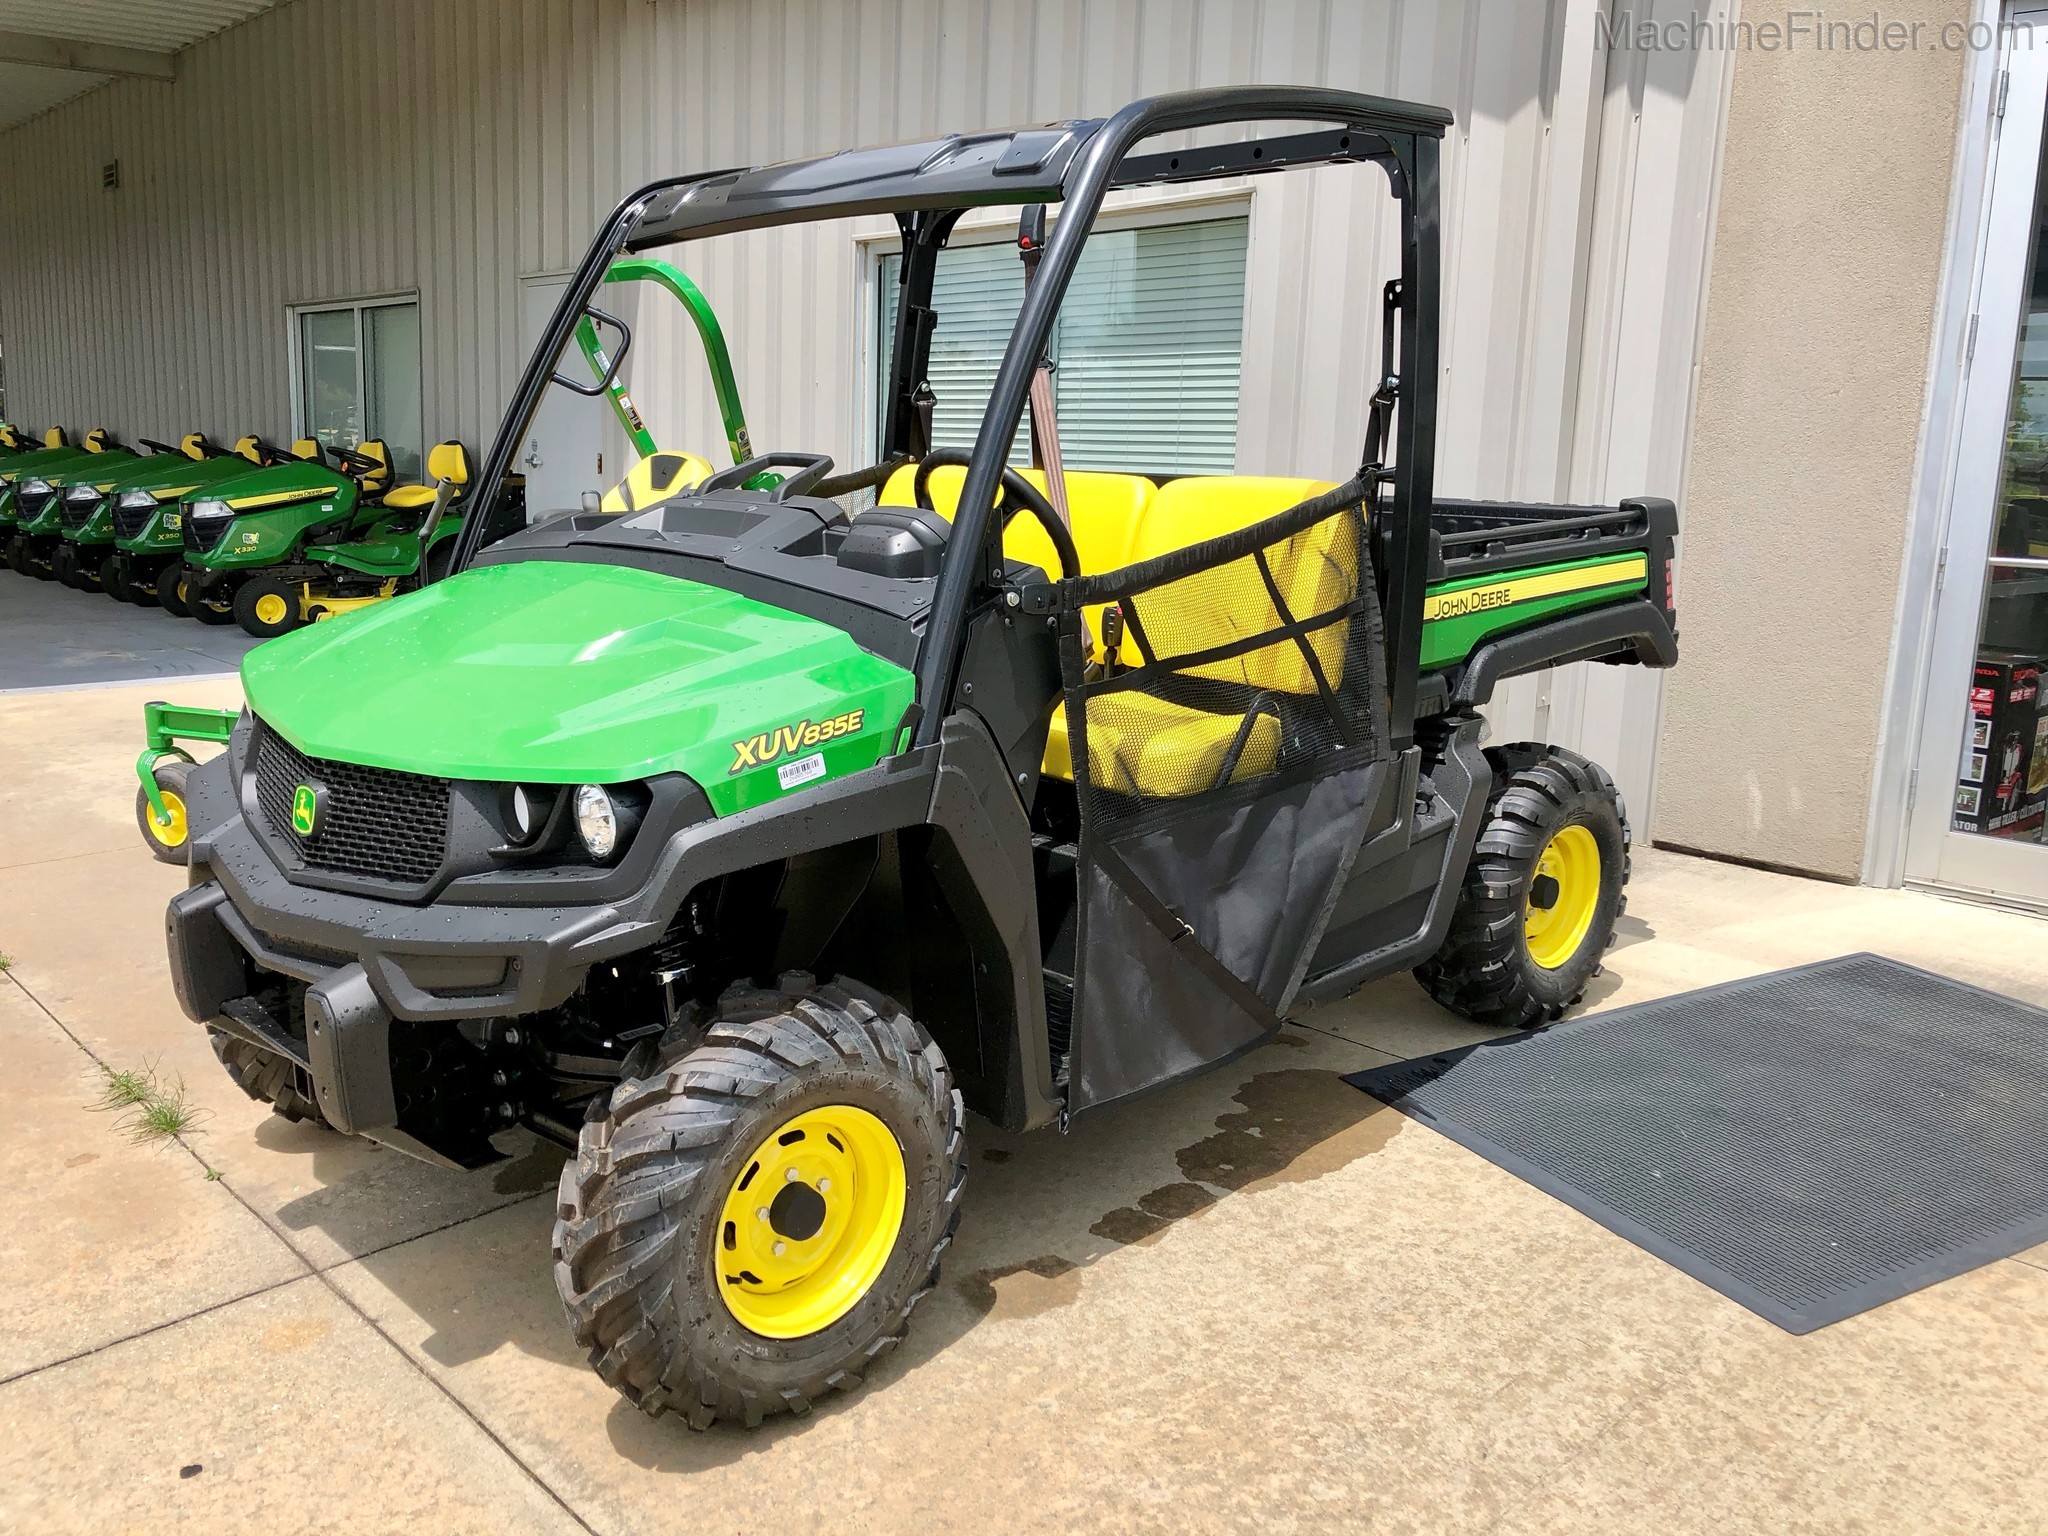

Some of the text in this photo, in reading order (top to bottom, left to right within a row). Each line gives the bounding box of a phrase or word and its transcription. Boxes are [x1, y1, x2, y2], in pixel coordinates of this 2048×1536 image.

[1434, 588, 1511, 618] JOHN DEERE
[729, 708, 866, 775] XUV835E
